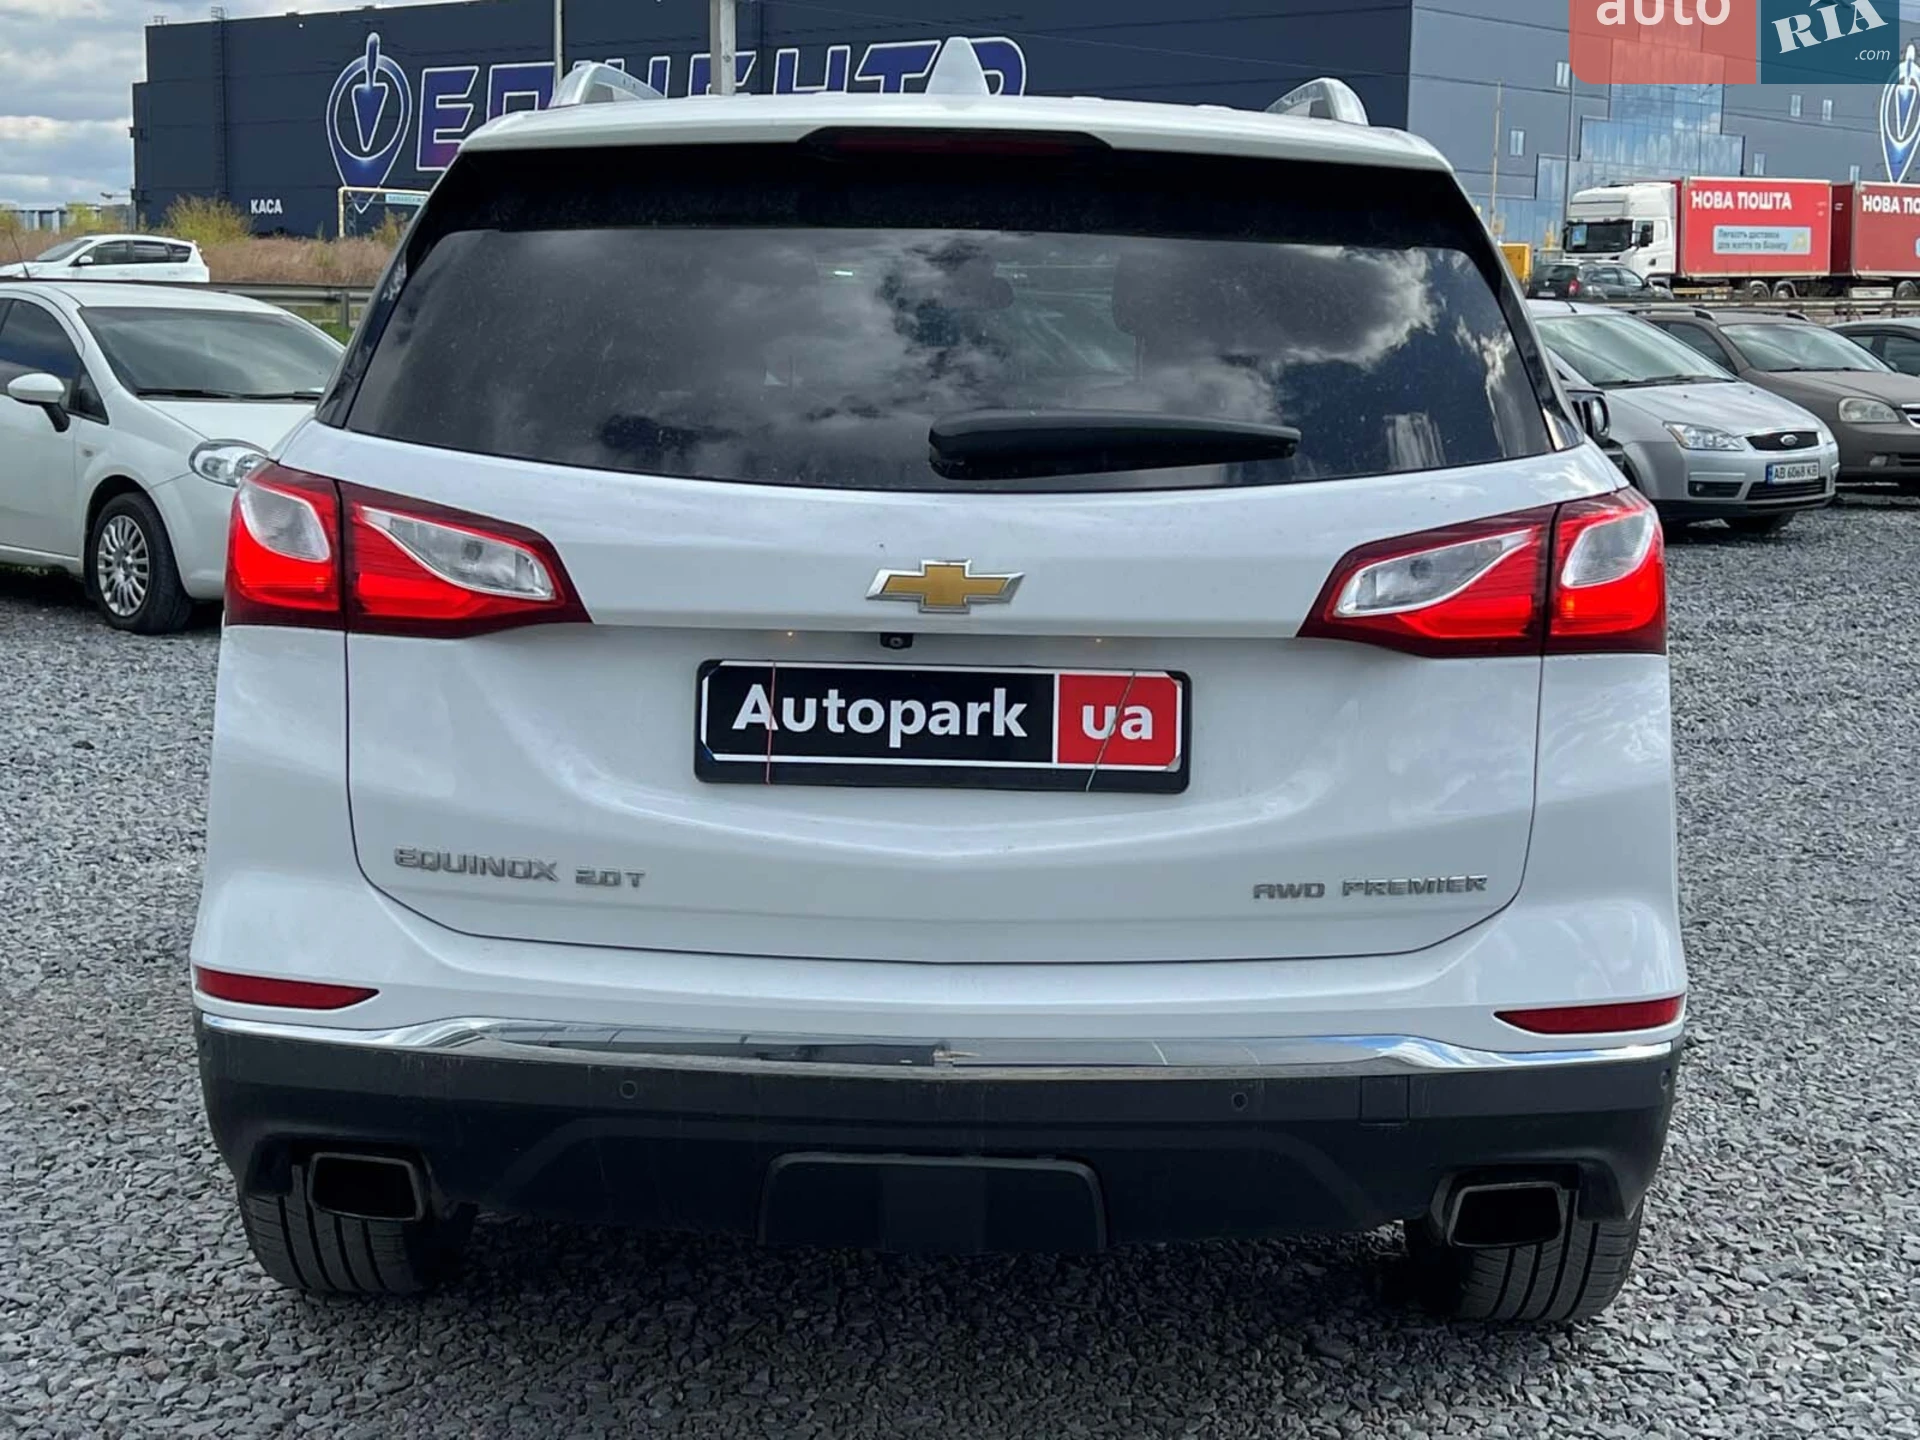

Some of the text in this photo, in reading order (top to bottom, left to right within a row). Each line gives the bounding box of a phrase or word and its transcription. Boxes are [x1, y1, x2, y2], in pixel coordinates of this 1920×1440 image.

[250, 199, 283, 214] КАСА
[1691, 190, 1793, 211] НОВА ПОШТА
[1862, 195, 1901, 213] НОВА
[731, 683, 1154, 748] Autopark ua
[393, 846, 561, 883] EQUINOX
[1253, 874, 1489, 899] AWD PREMIER
